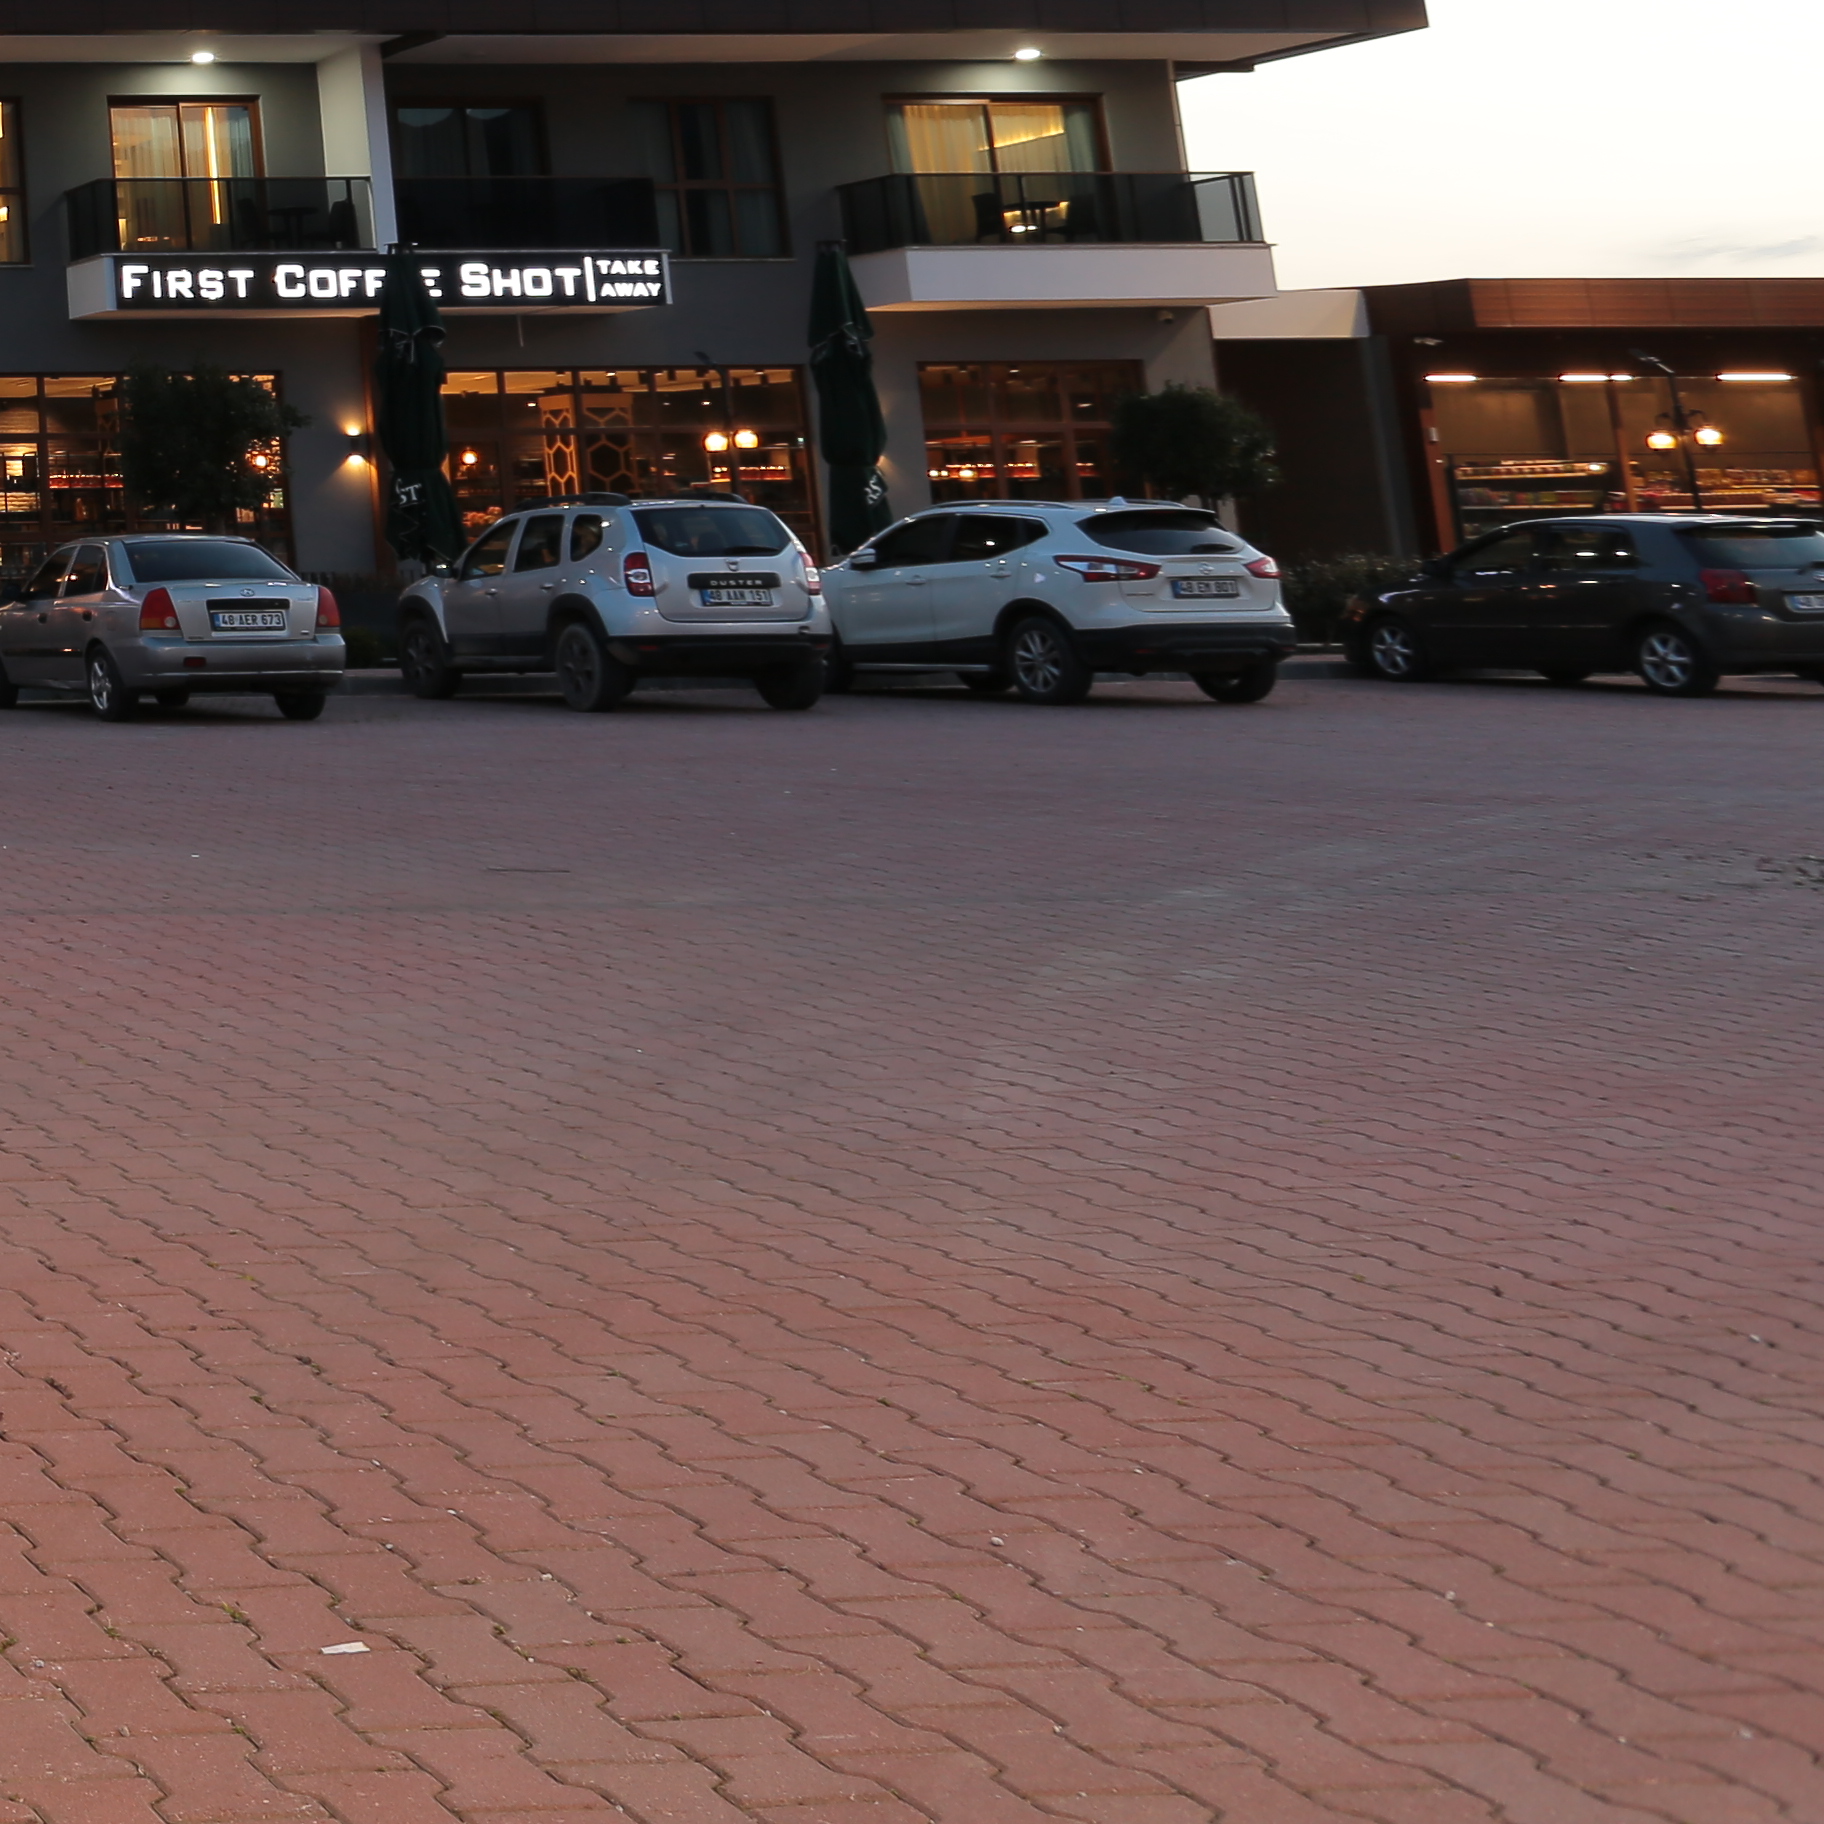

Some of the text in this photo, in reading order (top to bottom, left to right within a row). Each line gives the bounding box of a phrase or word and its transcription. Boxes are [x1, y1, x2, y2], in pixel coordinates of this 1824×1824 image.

[596, 259, 660, 276] TAKE
[121, 262, 583, 300] FIRST COFFE SHOT
[599, 281, 662, 298] AWAY
[221, 614, 235, 626] 48
[261, 614, 282, 626] 673
